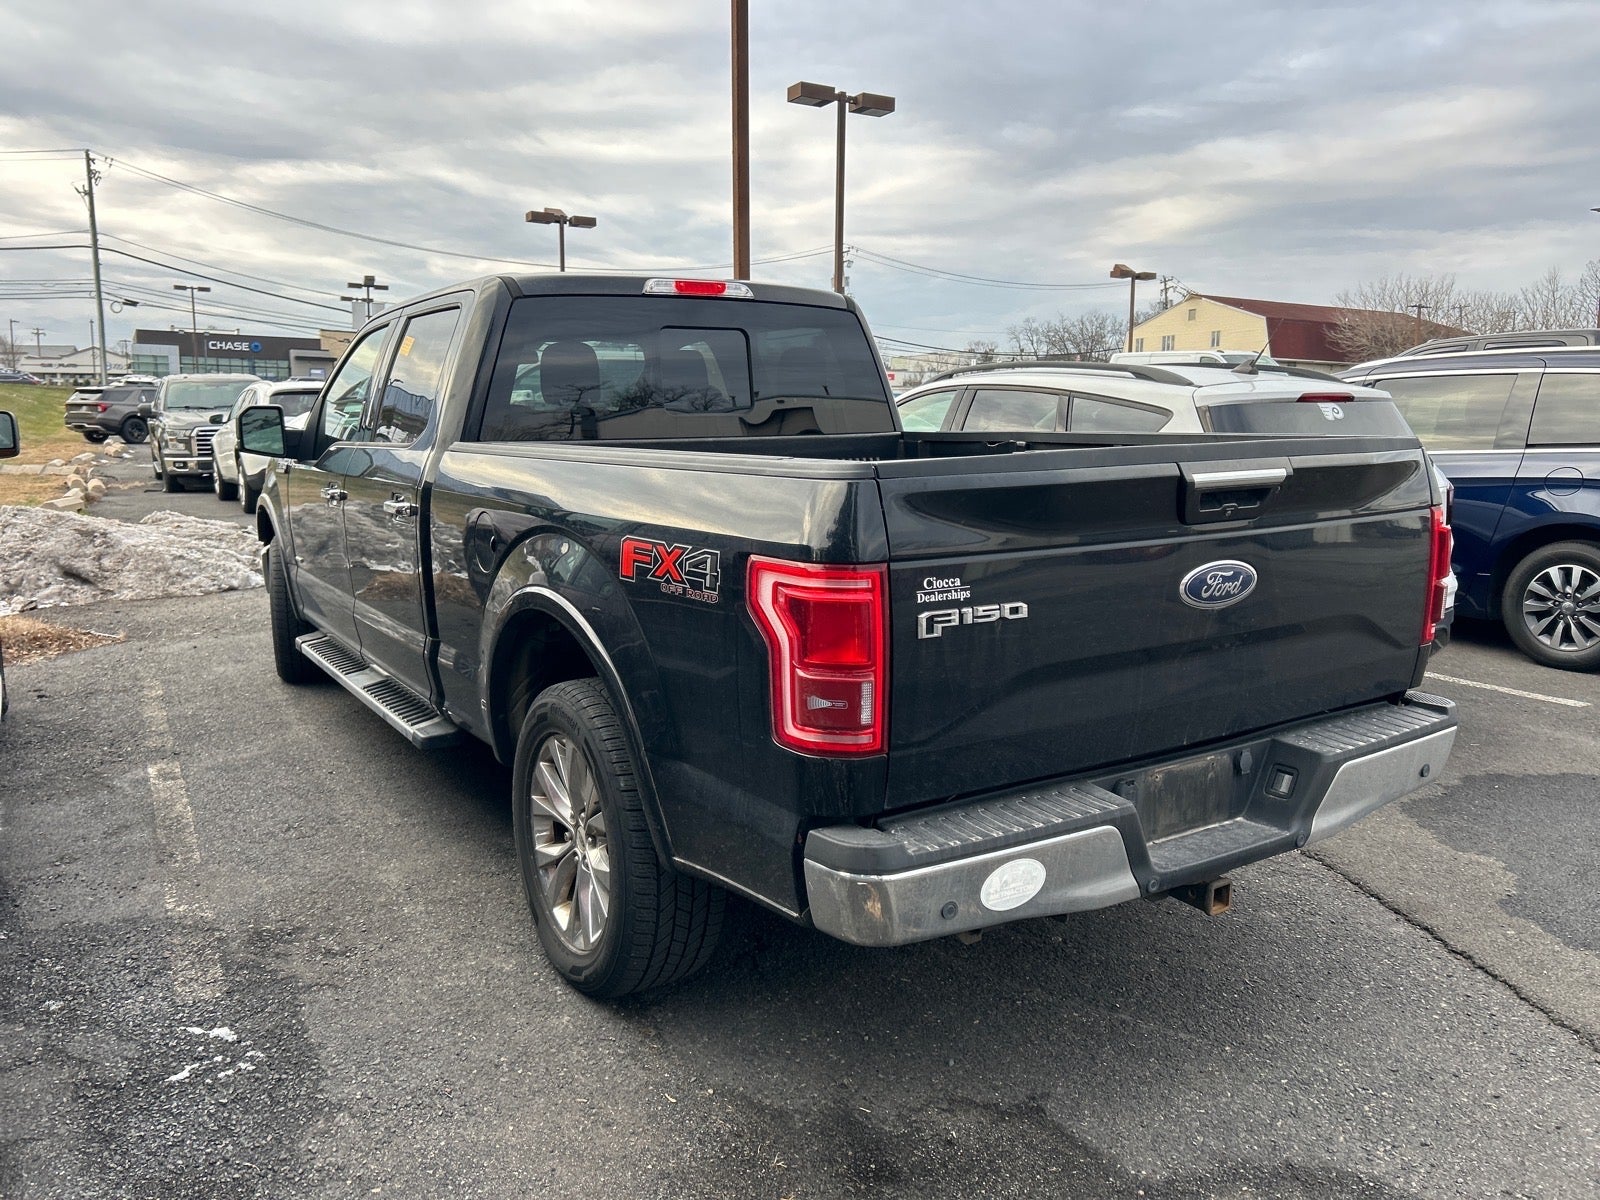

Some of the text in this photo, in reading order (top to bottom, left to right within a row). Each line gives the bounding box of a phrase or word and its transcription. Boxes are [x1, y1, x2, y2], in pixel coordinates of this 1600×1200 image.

[208, 340, 250, 351] CHASE
[619, 534, 720, 594] FX4
[660, 582, 719, 604] OFF ROAD
[923, 577, 961, 590] Ciocca
[1201, 571, 1244, 599] Ford
[916, 590, 971, 604] Dealerships
[917, 601, 1029, 640] F150
